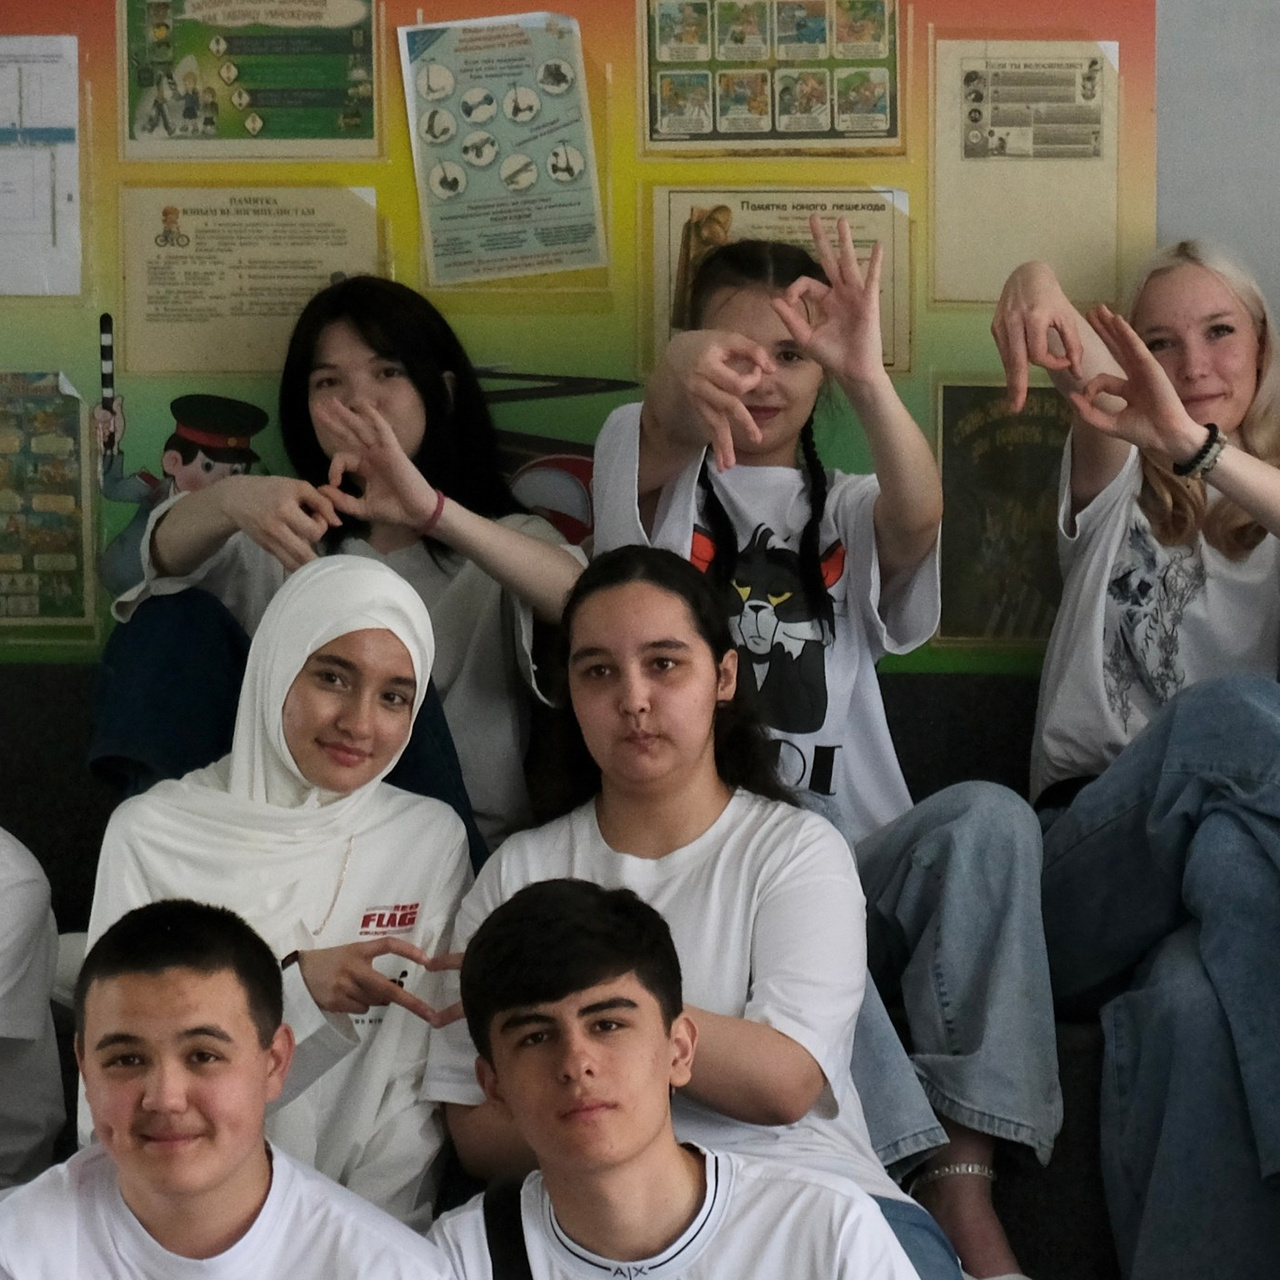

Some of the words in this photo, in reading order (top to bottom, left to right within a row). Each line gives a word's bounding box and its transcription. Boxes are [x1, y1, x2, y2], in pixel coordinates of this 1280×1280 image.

[740, 200, 788, 212] Памятка
[791, 202, 828, 212] юного
[832, 202, 886, 213] пешехода
[393, 902, 420, 912] RED
[360, 911, 418, 929] FLAG
